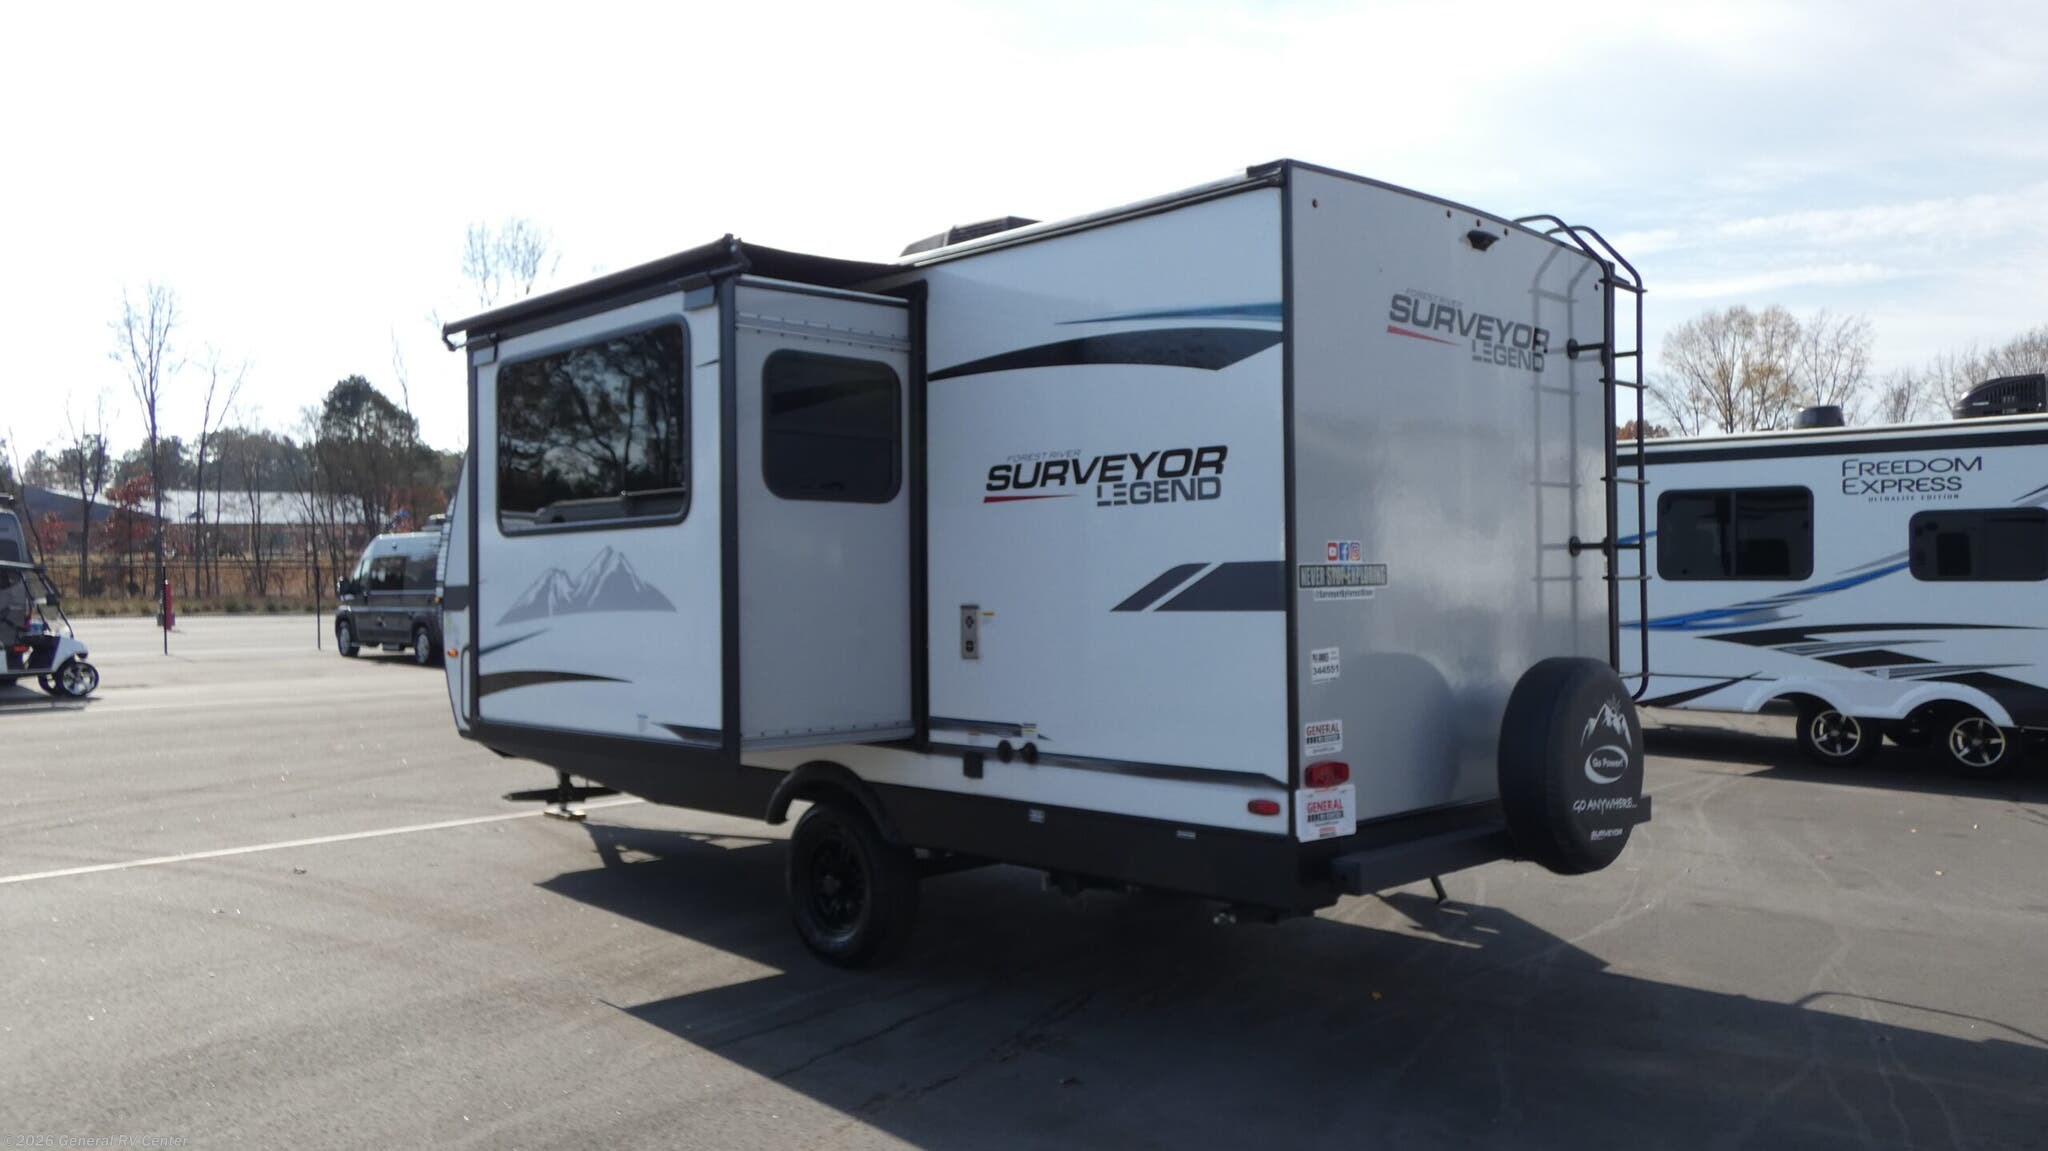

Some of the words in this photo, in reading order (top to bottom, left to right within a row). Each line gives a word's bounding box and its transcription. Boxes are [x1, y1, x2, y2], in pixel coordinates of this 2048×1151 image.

[1389, 293, 1550, 354] SURVEYOR
[1472, 339, 1545, 373] LEGEND
[1006, 451, 1049, 463] FOREST
[1051, 449, 1082, 459] RIVER
[985, 445, 1229, 492] SURVEYOR
[1842, 456, 1983, 477] FREEDOM
[1097, 476, 1222, 507] LEGEND
[1842, 476, 1963, 496] EXPRESS
[1301, 566, 1326, 586] NEVER
[1306, 723, 1339, 736] GENERAL
[1592, 758, 1602, 768] Go
[1307, 799, 1343, 813] GENERAL
[1572, 800, 1587, 814] GO
